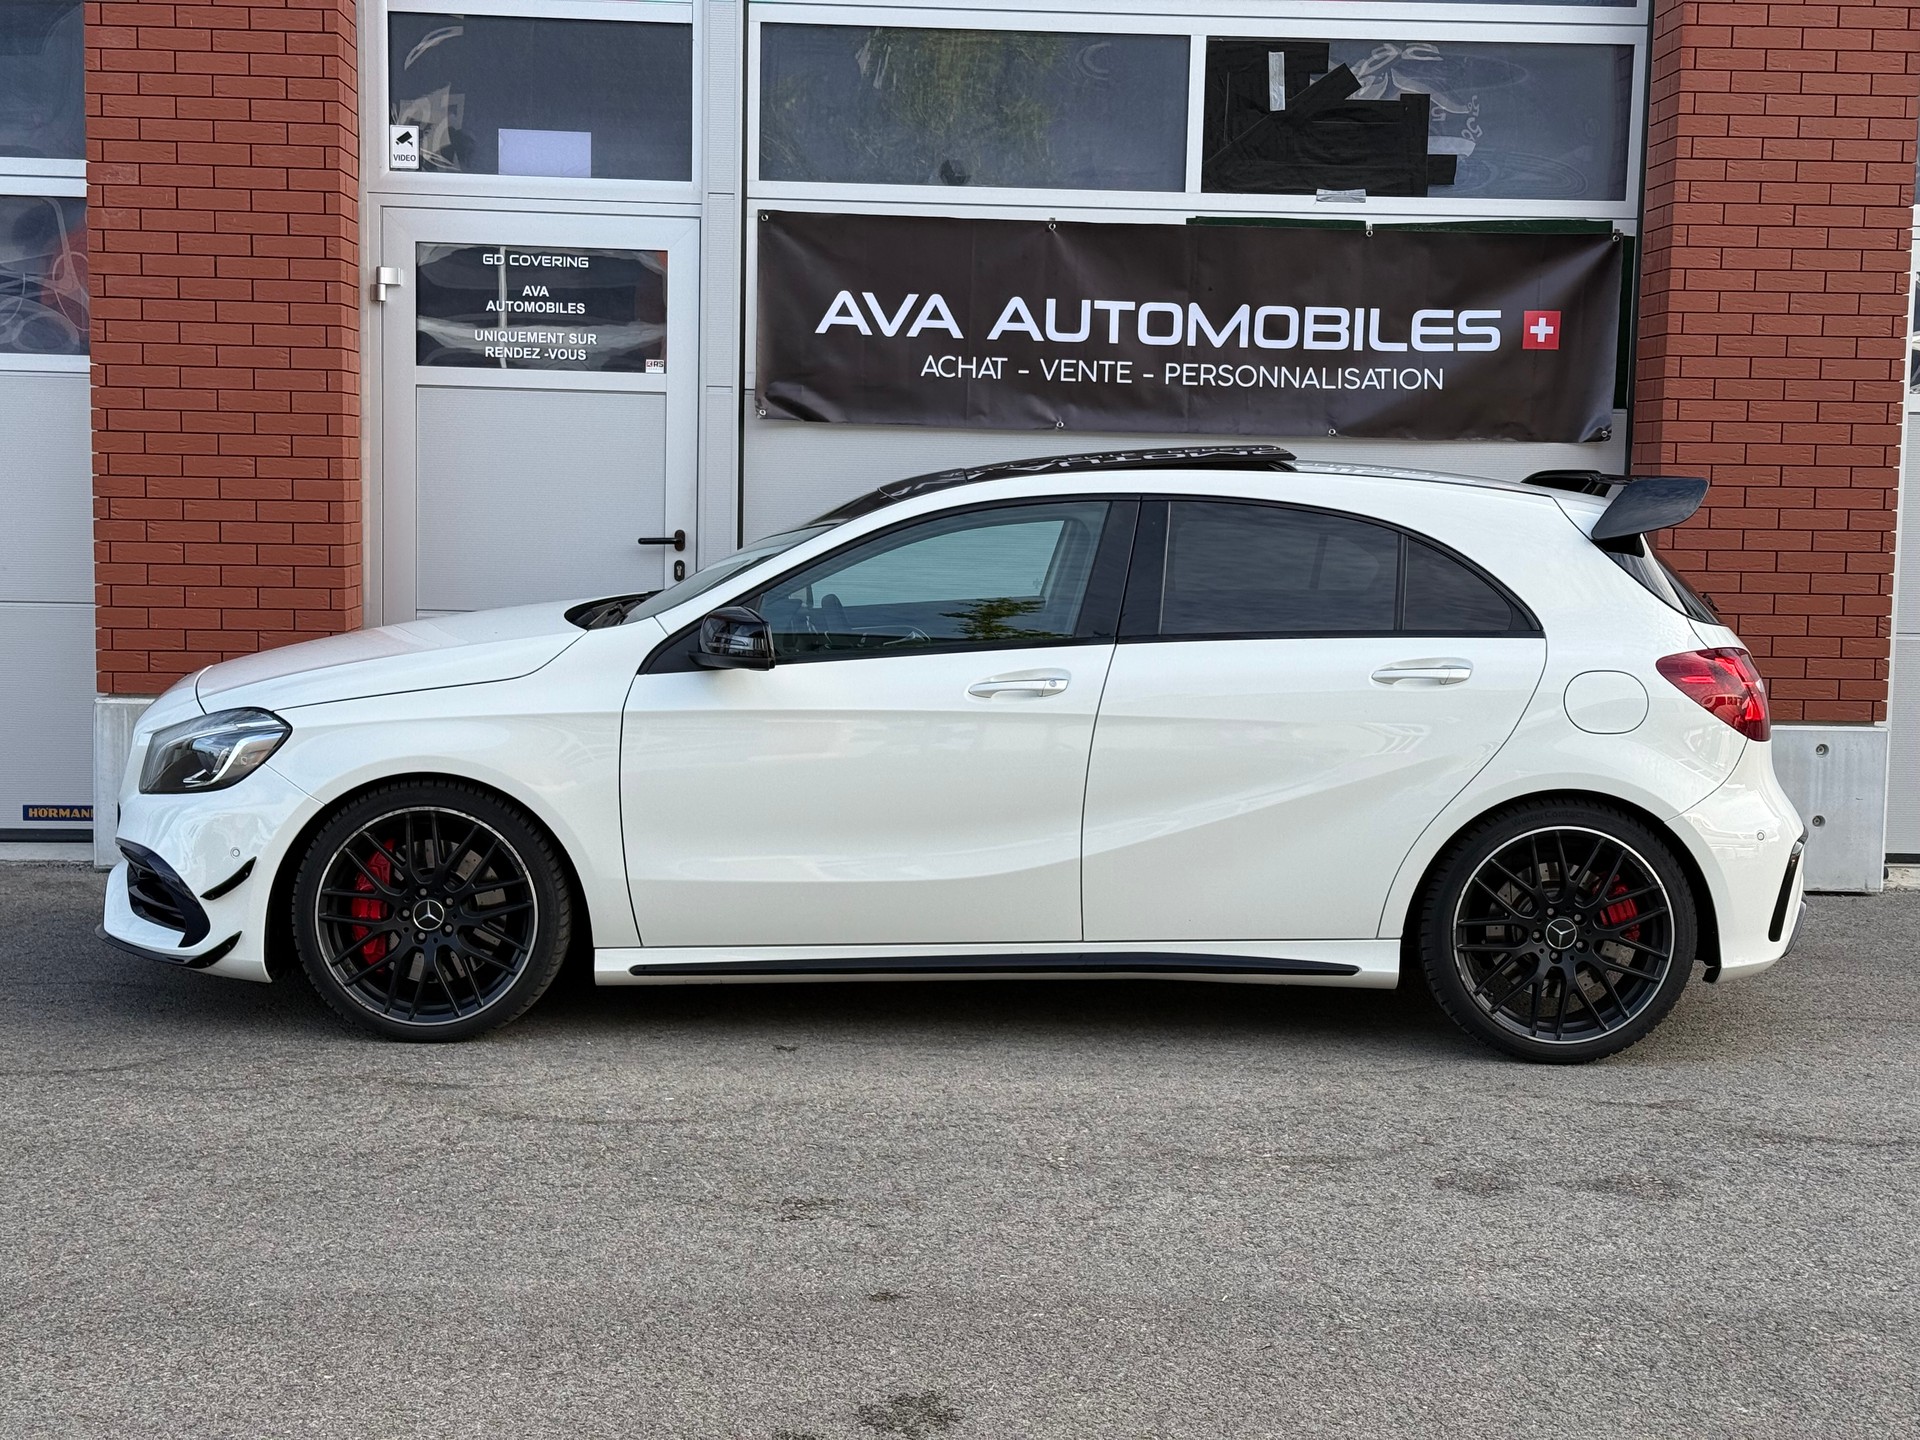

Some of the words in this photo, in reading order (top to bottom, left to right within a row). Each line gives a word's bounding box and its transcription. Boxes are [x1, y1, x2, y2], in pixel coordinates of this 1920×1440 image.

[393, 154, 417, 162] VIDEO
[482, 253, 505, 265] GD
[509, 254, 589, 268] COVERING
[522, 285, 550, 297] AVA
[485, 300, 586, 314] AUTOMOBILES
[814, 290, 964, 339] AVA
[986, 296, 1502, 352] AUTOMOBILES
[474, 329, 565, 344] UNIQUEMENT
[568, 333, 598, 345] SUR
[485, 346, 540, 359] RENDEZ
[920, 354, 1008, 380] ACHAT
[1040, 358, 1133, 384] VENTE
[1164, 362, 1444, 390] PERSONNALISATION
[28, 807, 94, 818] HÖRMAN
